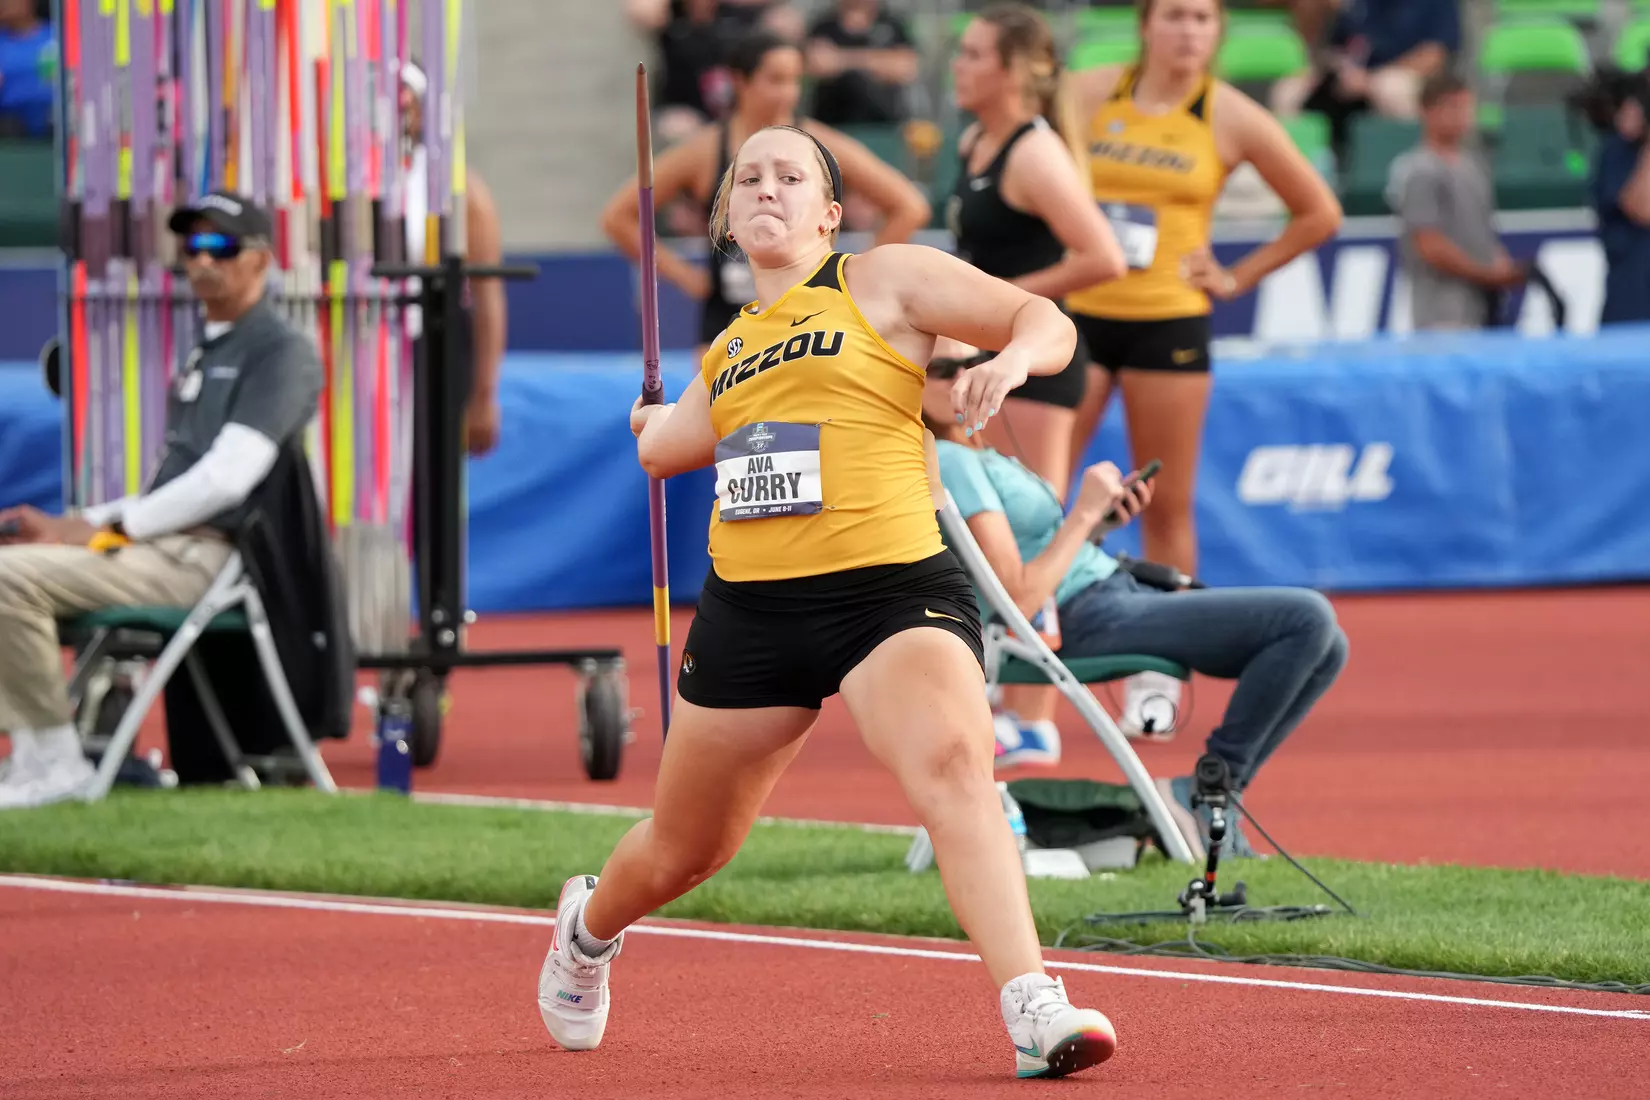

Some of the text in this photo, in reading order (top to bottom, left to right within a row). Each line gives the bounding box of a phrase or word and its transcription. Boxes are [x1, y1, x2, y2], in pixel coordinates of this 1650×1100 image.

[710, 330, 845, 408] MIZZOU
[747, 455, 774, 475] AVA
[1236, 442, 1395, 513] GILL
[727, 472, 802, 504] CURRY
[556, 989, 583, 1004] NIKE
